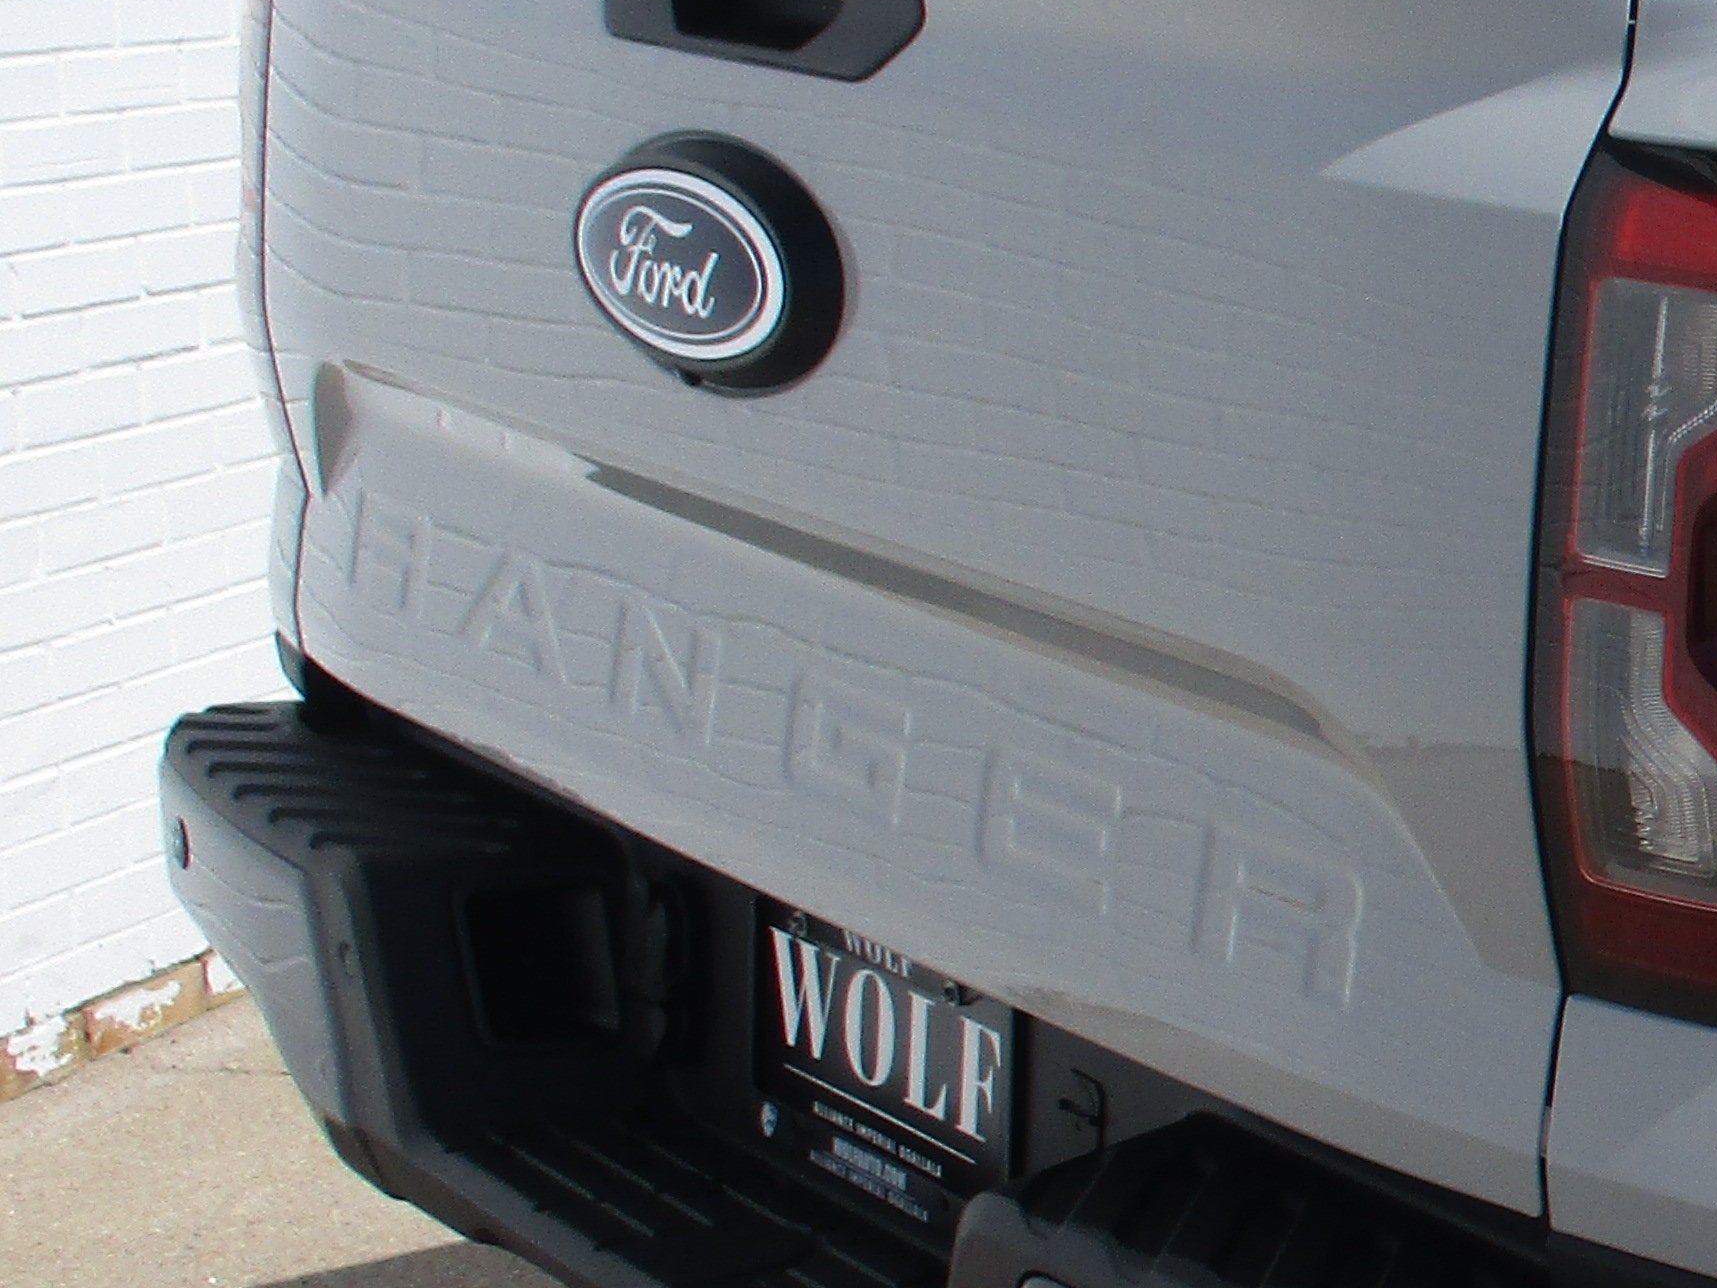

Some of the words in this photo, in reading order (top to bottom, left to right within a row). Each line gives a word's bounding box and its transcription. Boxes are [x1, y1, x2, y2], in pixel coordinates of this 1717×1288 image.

[609, 204, 721, 319] Ford
[347, 488, 1368, 1014] RANGER
[768, 924, 1001, 1144] WOLF
[842, 929, 912, 979] WOLF
